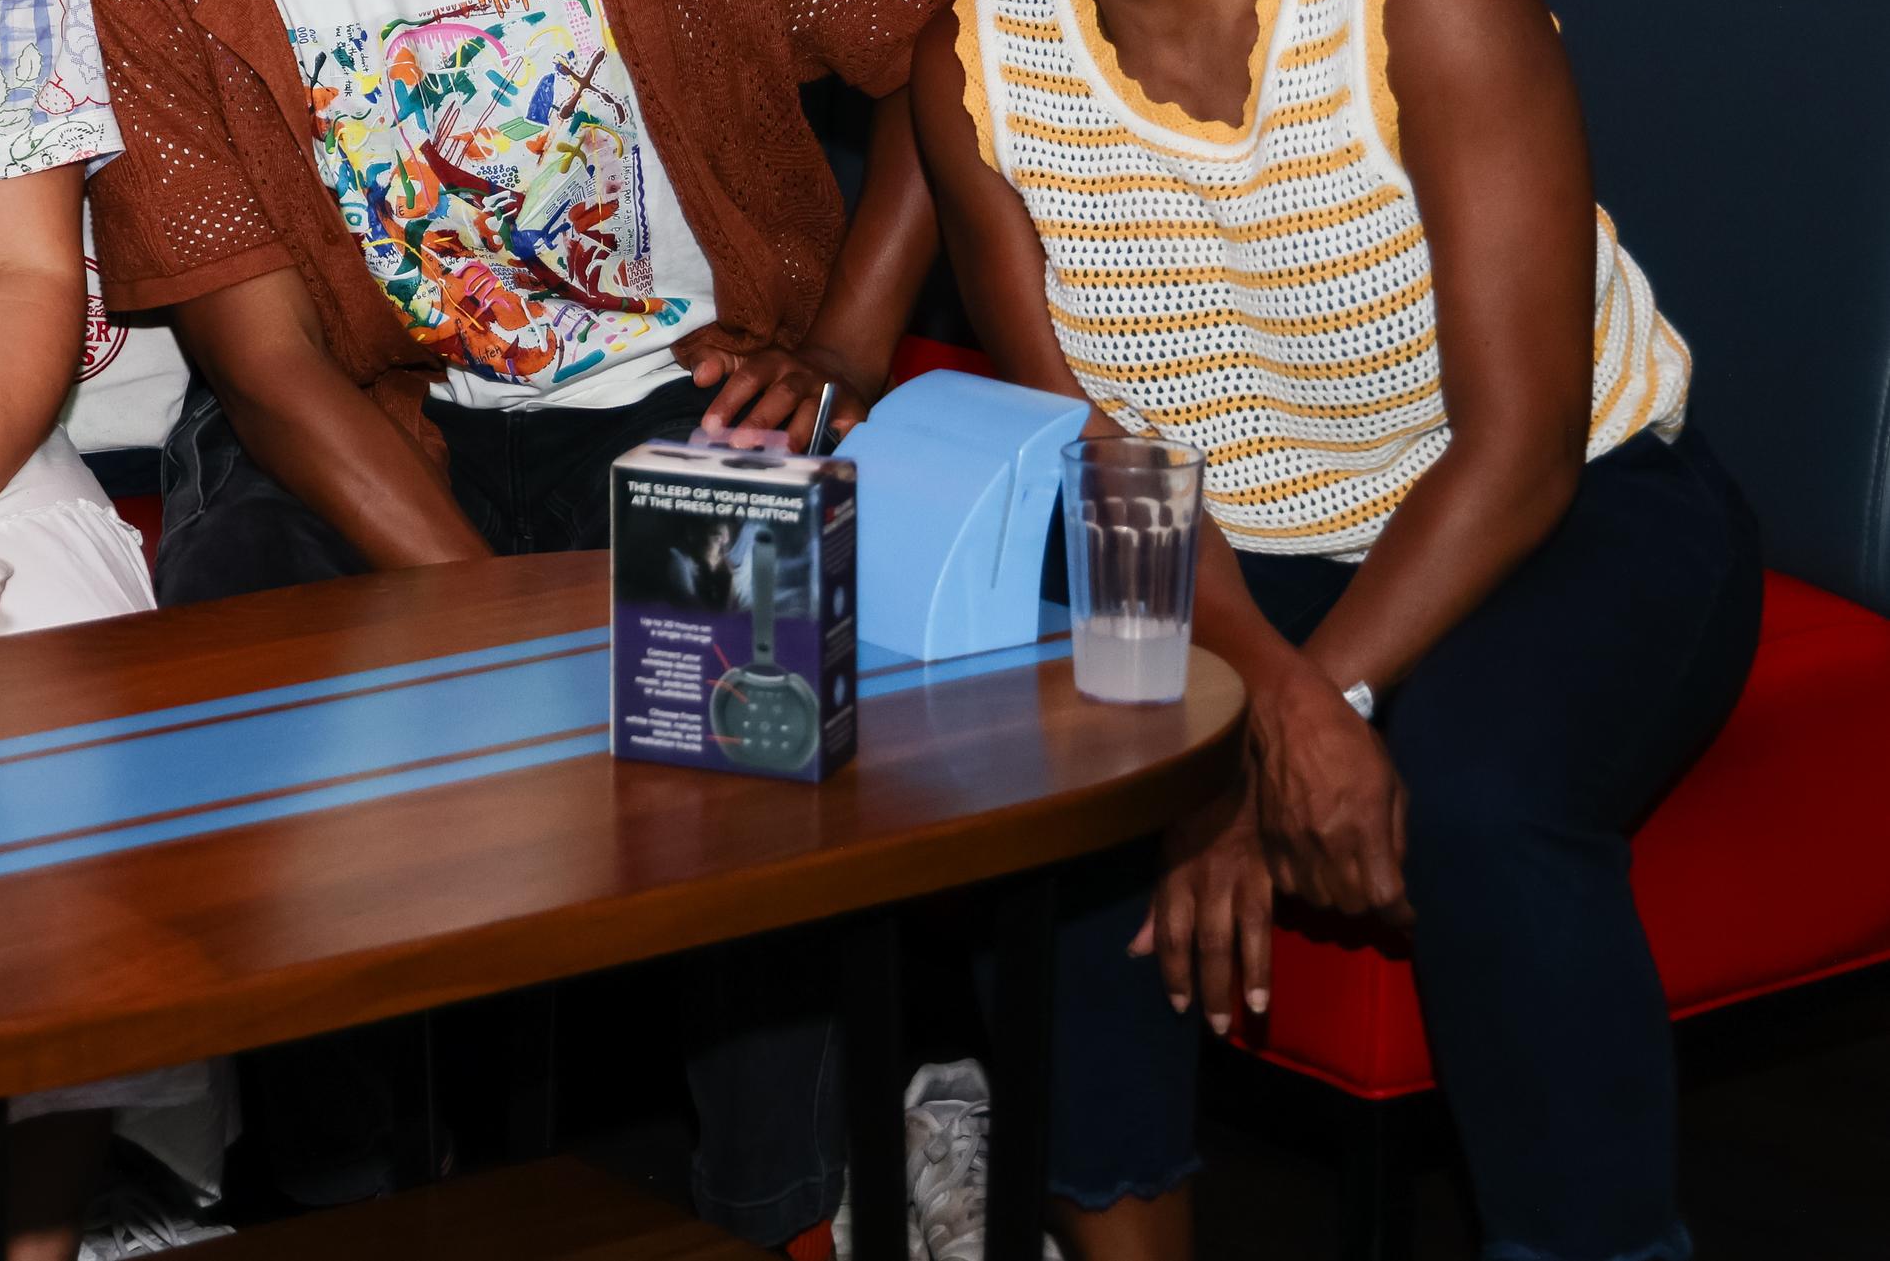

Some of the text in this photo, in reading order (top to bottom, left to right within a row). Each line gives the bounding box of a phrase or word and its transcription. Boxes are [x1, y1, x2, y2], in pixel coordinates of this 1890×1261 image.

[628, 480, 804, 510] THE SLEEP OF YOUR DREAMS
[631, 494, 799, 523] AT THE PRESS OF A BUTTON
